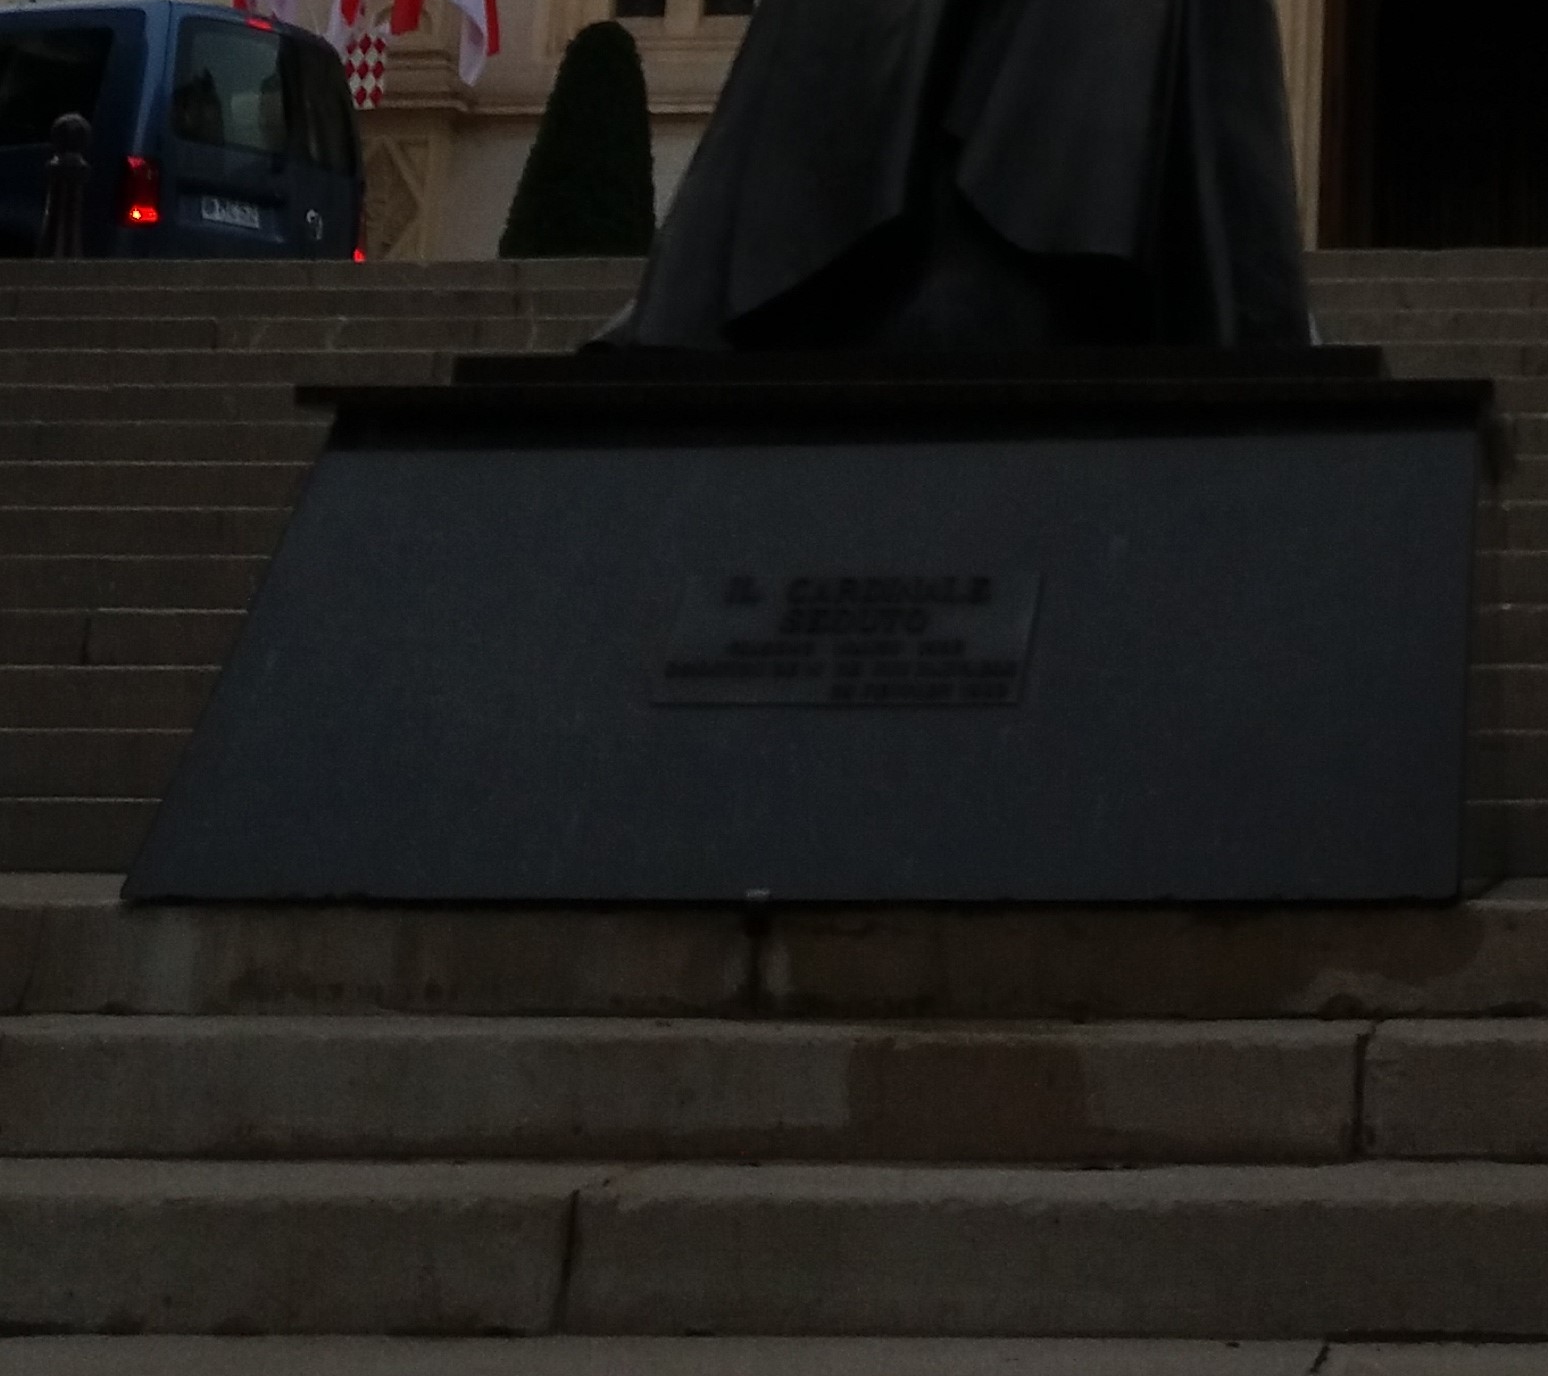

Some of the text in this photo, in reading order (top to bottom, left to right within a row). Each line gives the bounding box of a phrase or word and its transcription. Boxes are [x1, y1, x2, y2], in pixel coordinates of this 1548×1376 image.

[725, 576, 992, 605] IL CARDINALE
[778, 607, 931, 634] SEDUTO
